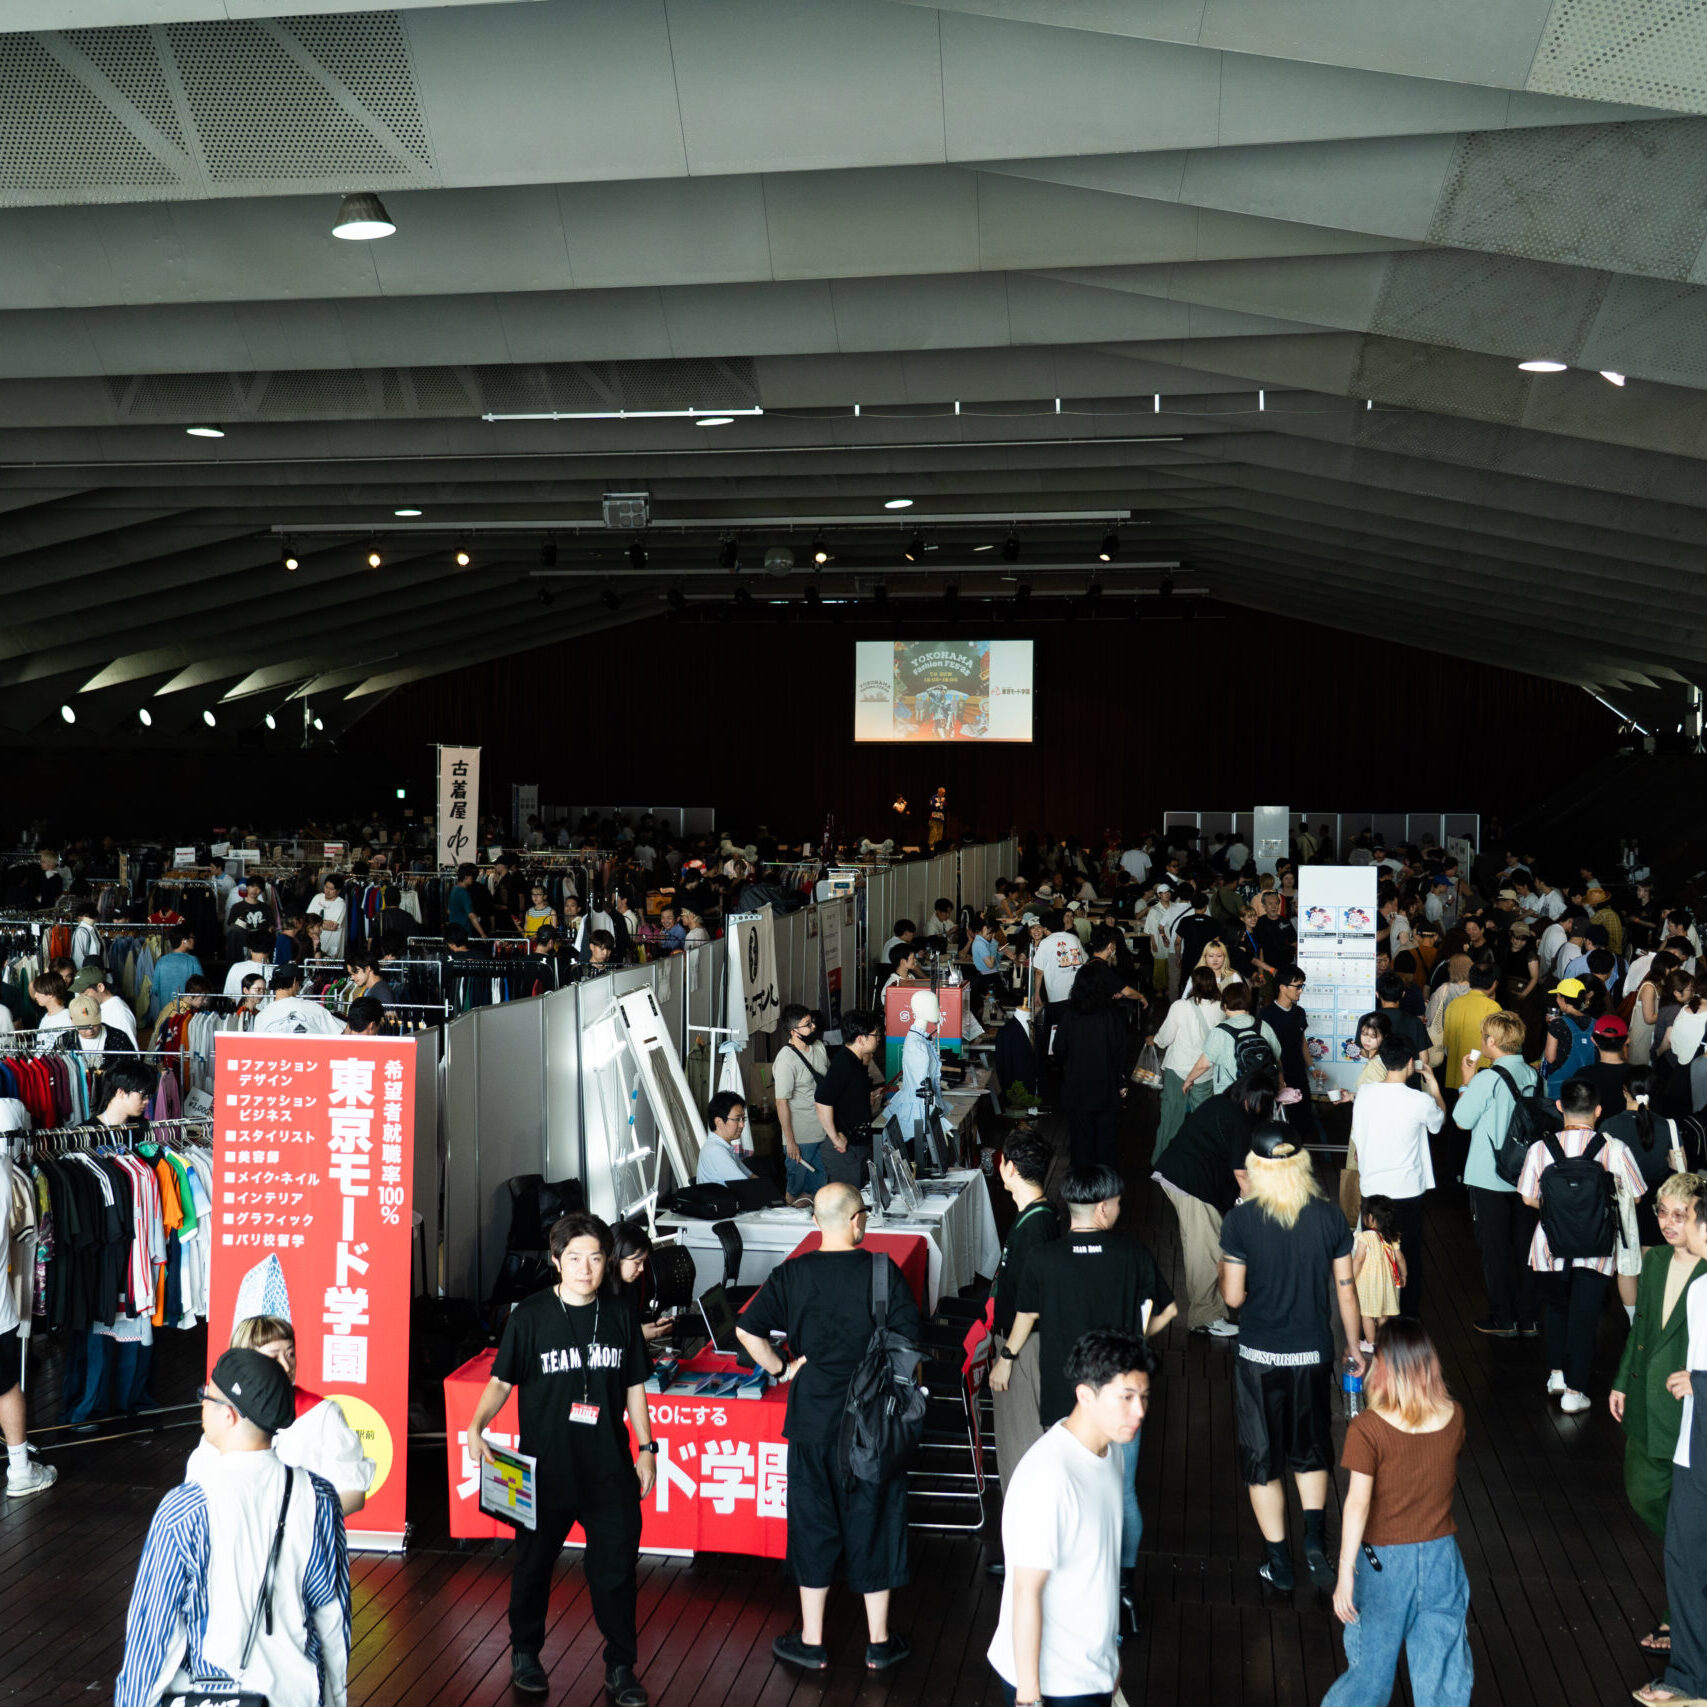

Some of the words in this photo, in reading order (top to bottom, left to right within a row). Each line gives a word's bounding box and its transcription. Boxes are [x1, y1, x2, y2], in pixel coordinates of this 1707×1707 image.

[911, 651, 973, 668] YOKOHAMA
[912, 660, 943, 676] Fashion
[241, 1059, 318, 1072] ファッション
[239, 1074, 293, 1087] デザイン
[239, 1095, 317, 1107] ファッション
[239, 1109, 293, 1122] ビジネス
[238, 1130, 316, 1144] スタイリスト
[238, 1151, 280, 1164] 美容師
[237, 1171, 320, 1186] メイク・ネイル
[236, 1192, 304, 1206] インテリア
[236, 1212, 314, 1227] グラフィック
[323, 1057, 376, 1384] 東京モード学園
[236, 1234, 305, 1247] パリ校留学
[540, 1347, 582, 1374] TEAM
